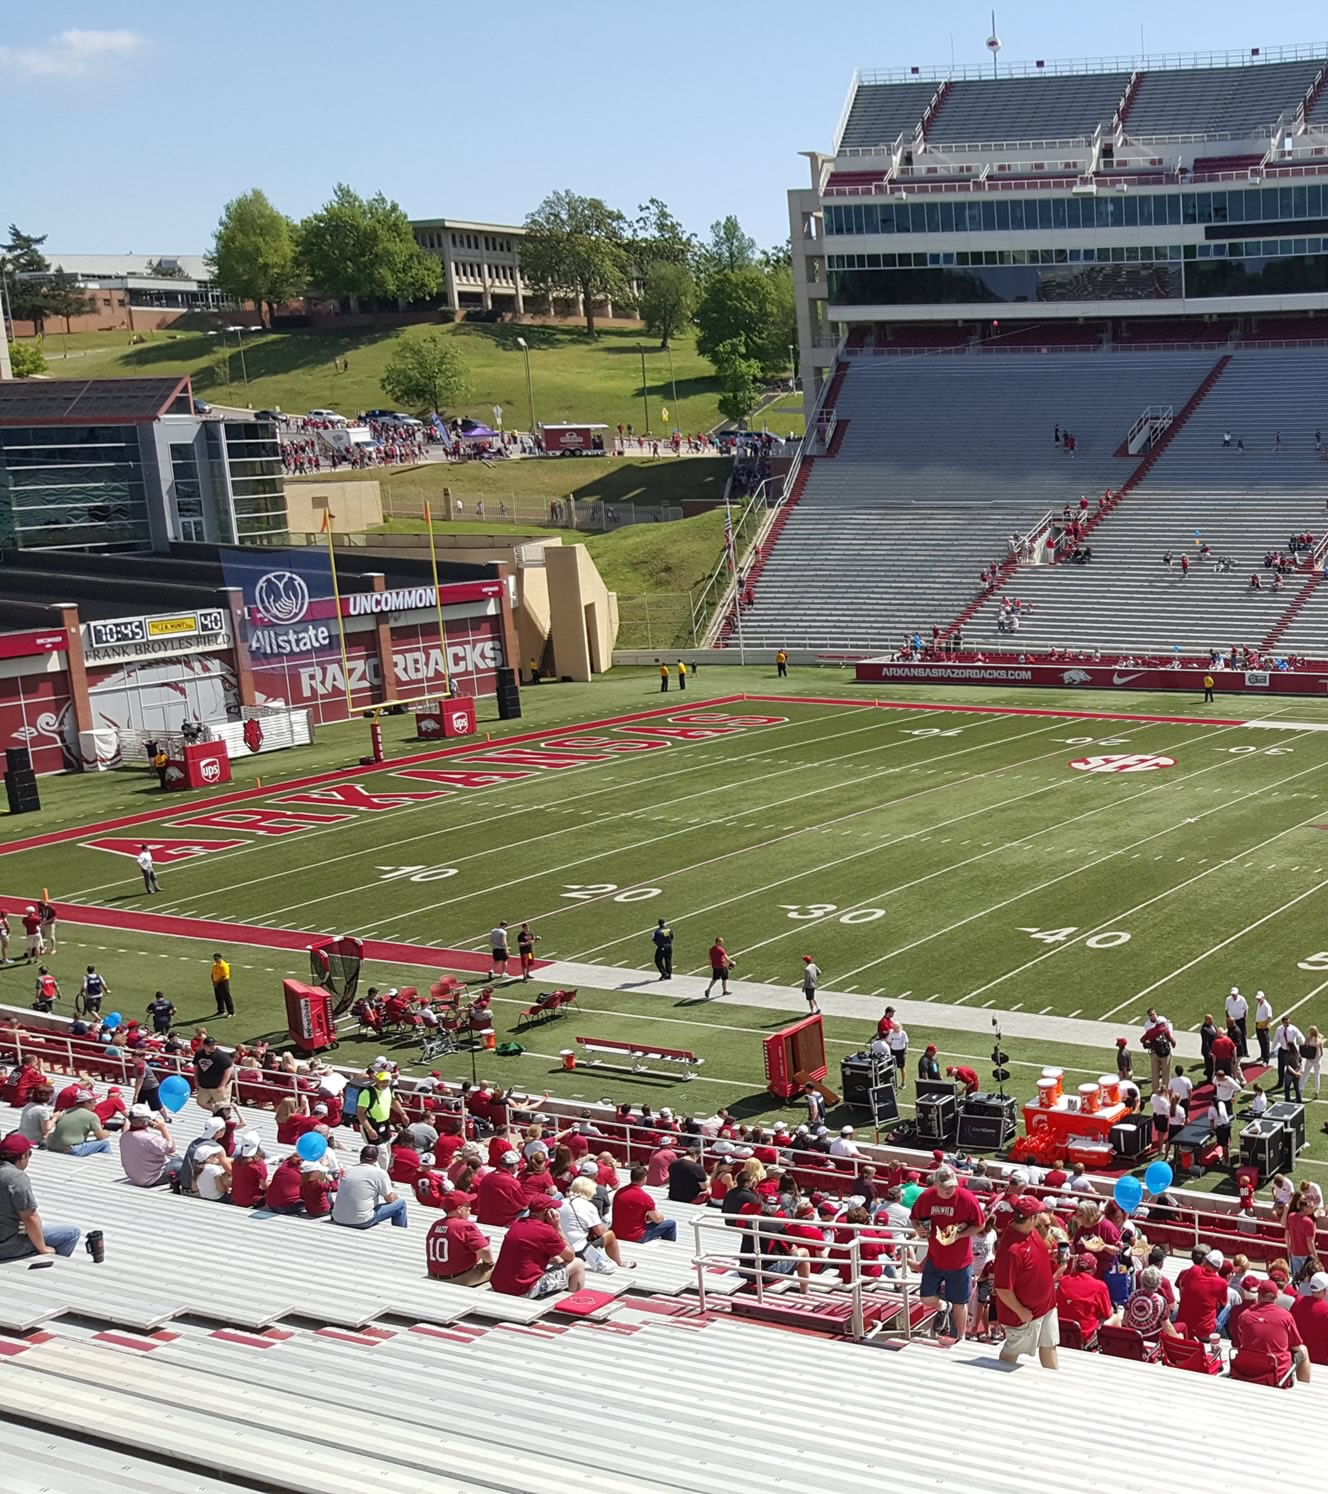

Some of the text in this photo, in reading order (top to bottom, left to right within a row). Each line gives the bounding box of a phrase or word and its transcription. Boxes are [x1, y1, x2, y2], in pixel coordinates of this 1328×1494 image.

[349, 588, 437, 616] UNCOMMON
[95, 621, 144, 643] 70:45
[200, 612, 222, 630] 40
[85, 632, 231, 663] FRANK BROYLES FIELD
[250, 624, 330, 655] Allstate
[298, 639, 503, 698] RAZORBACKS
[881, 667, 1032, 680] ARKANSASRAZORBACKS.COM
[201, 764, 220, 780] ups
[77, 712, 791, 866] ARKANSAS
[428, 1237, 449, 1263] 10
